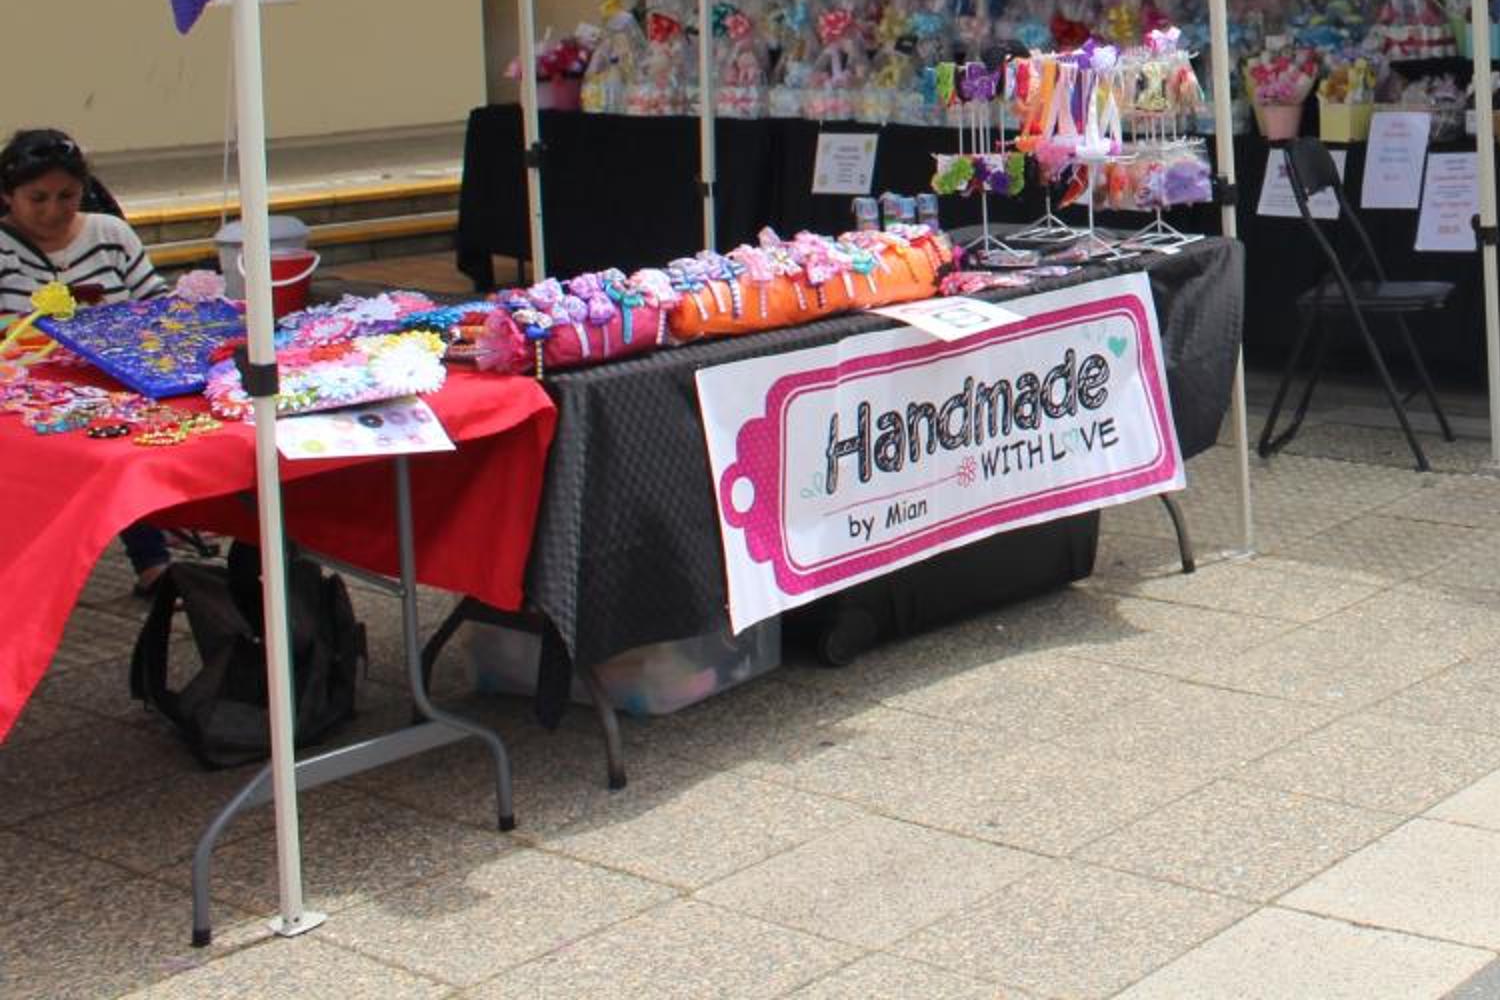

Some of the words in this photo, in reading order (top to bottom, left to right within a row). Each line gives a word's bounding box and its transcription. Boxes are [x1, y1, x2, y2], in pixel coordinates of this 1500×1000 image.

[825, 347, 1111, 495] Handmade
[980, 434, 1044, 480] WITH
[849, 514, 875, 542] by
[885, 499, 928, 529] Mian
